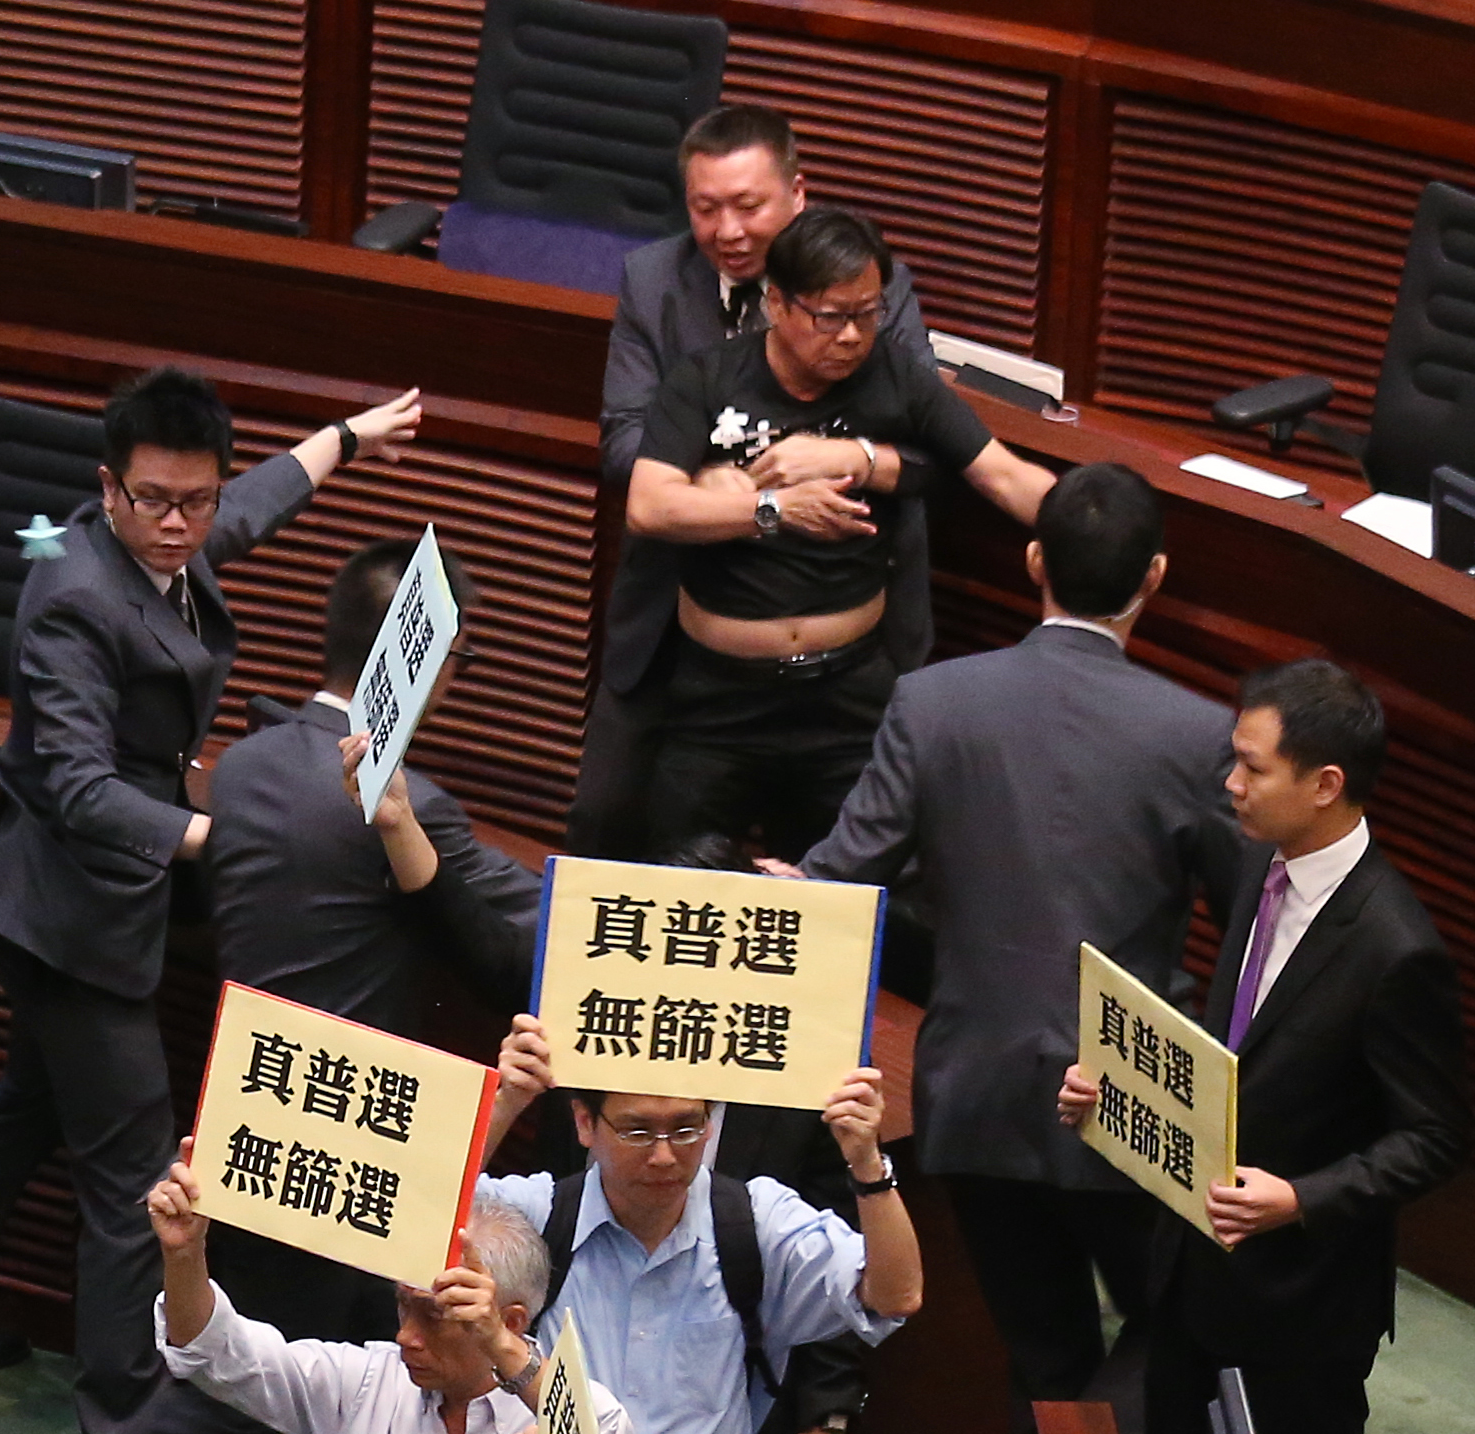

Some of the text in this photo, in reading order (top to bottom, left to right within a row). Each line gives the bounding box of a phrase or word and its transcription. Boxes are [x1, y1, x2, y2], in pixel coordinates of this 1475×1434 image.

[586, 894, 802, 975] 真普選
[241, 1031, 420, 1143] 真普選
[574, 988, 792, 1072] 無篩選
[1099, 991, 1194, 1110] 真普選
[220, 1123, 401, 1239] 無篩選
[1098, 1072, 1194, 1192] 無篩選
